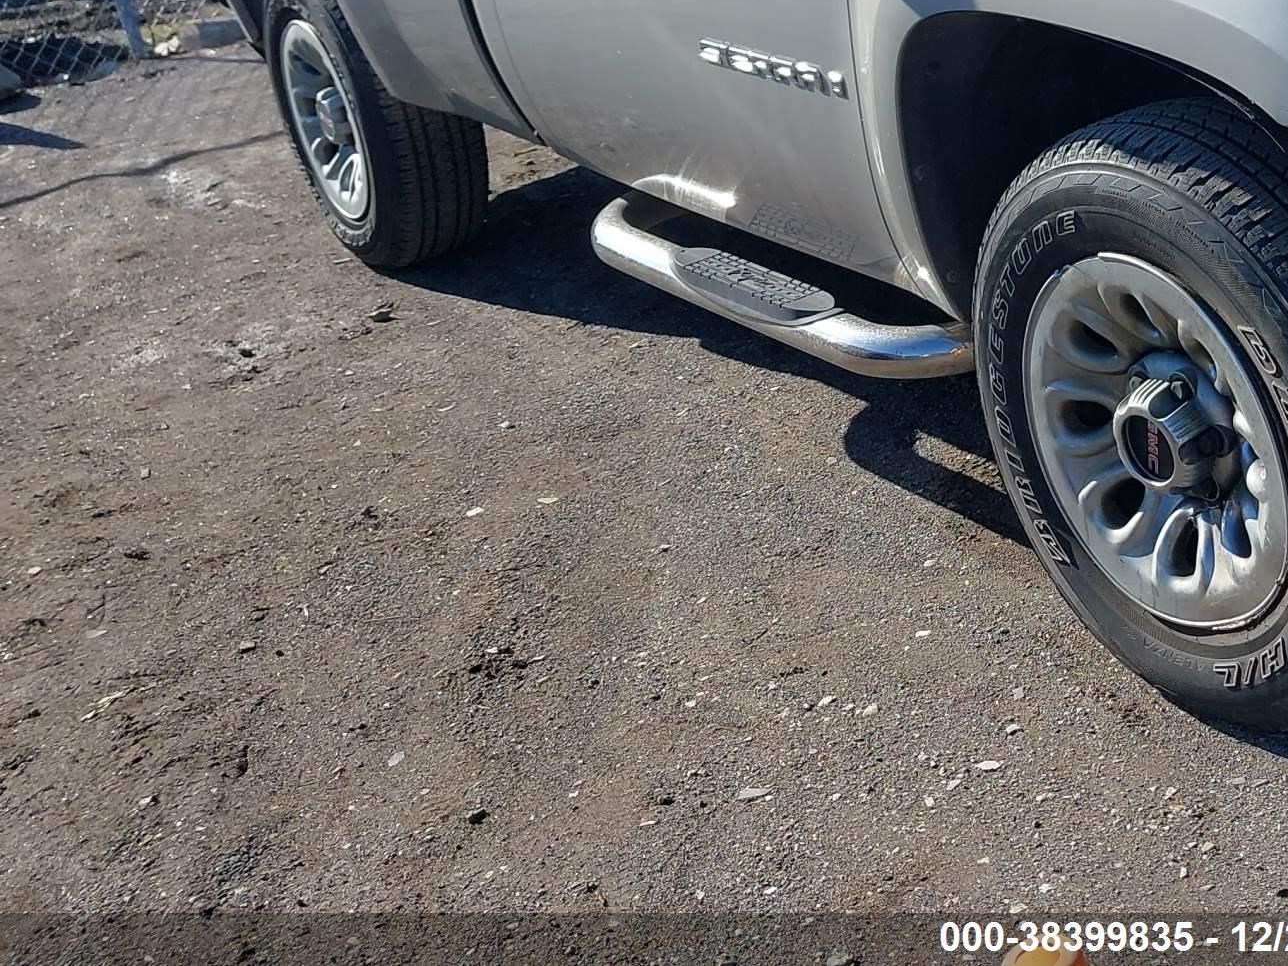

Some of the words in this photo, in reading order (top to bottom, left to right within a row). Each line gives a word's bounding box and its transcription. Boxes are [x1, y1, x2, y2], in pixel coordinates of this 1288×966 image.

[988, 208, 1077, 567] BRIDGESTONE
[1147, 419, 1159, 474] GMC
[1212, 636, 1288, 688] H/L
